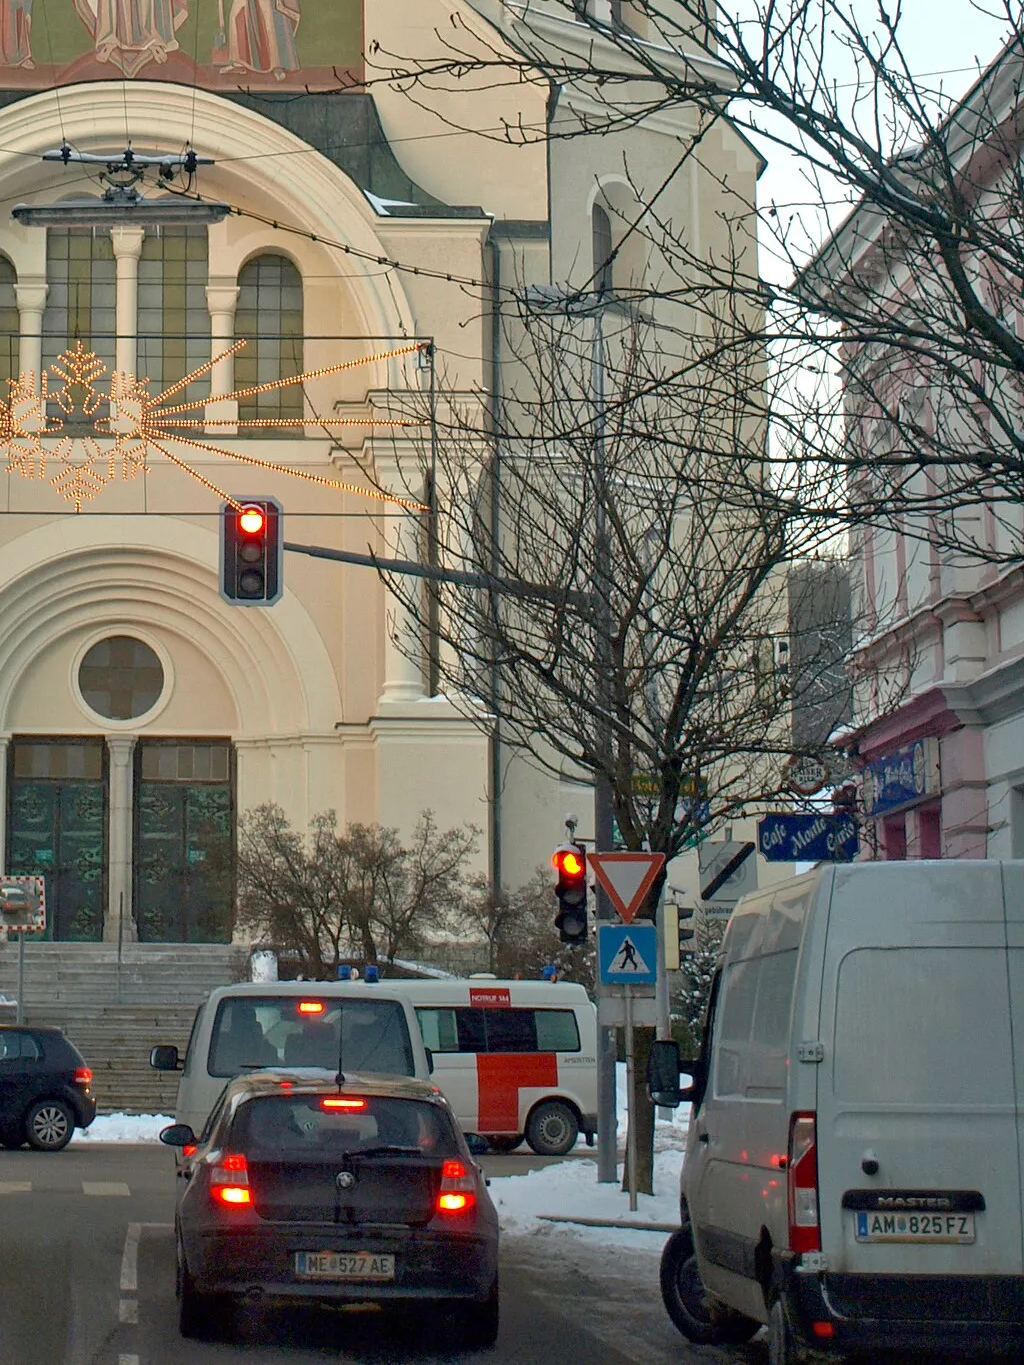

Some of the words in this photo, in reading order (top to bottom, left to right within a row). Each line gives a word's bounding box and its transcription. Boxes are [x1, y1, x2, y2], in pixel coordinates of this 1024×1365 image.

[762, 823, 786, 850] Cafe
[790, 817, 826, 857] Monte
[471, 995, 497, 1003] NOTRUF
[877, 1197, 950, 1208] MASTER
[871, 1216, 895, 1234] AM
[909, 1216, 942, 1234] 825
[946, 1217, 969, 1235] FZ
[308, 1256, 327, 1273] ME
[338, 1257, 367, 1274] 527
[370, 1258, 388, 1274] AE
